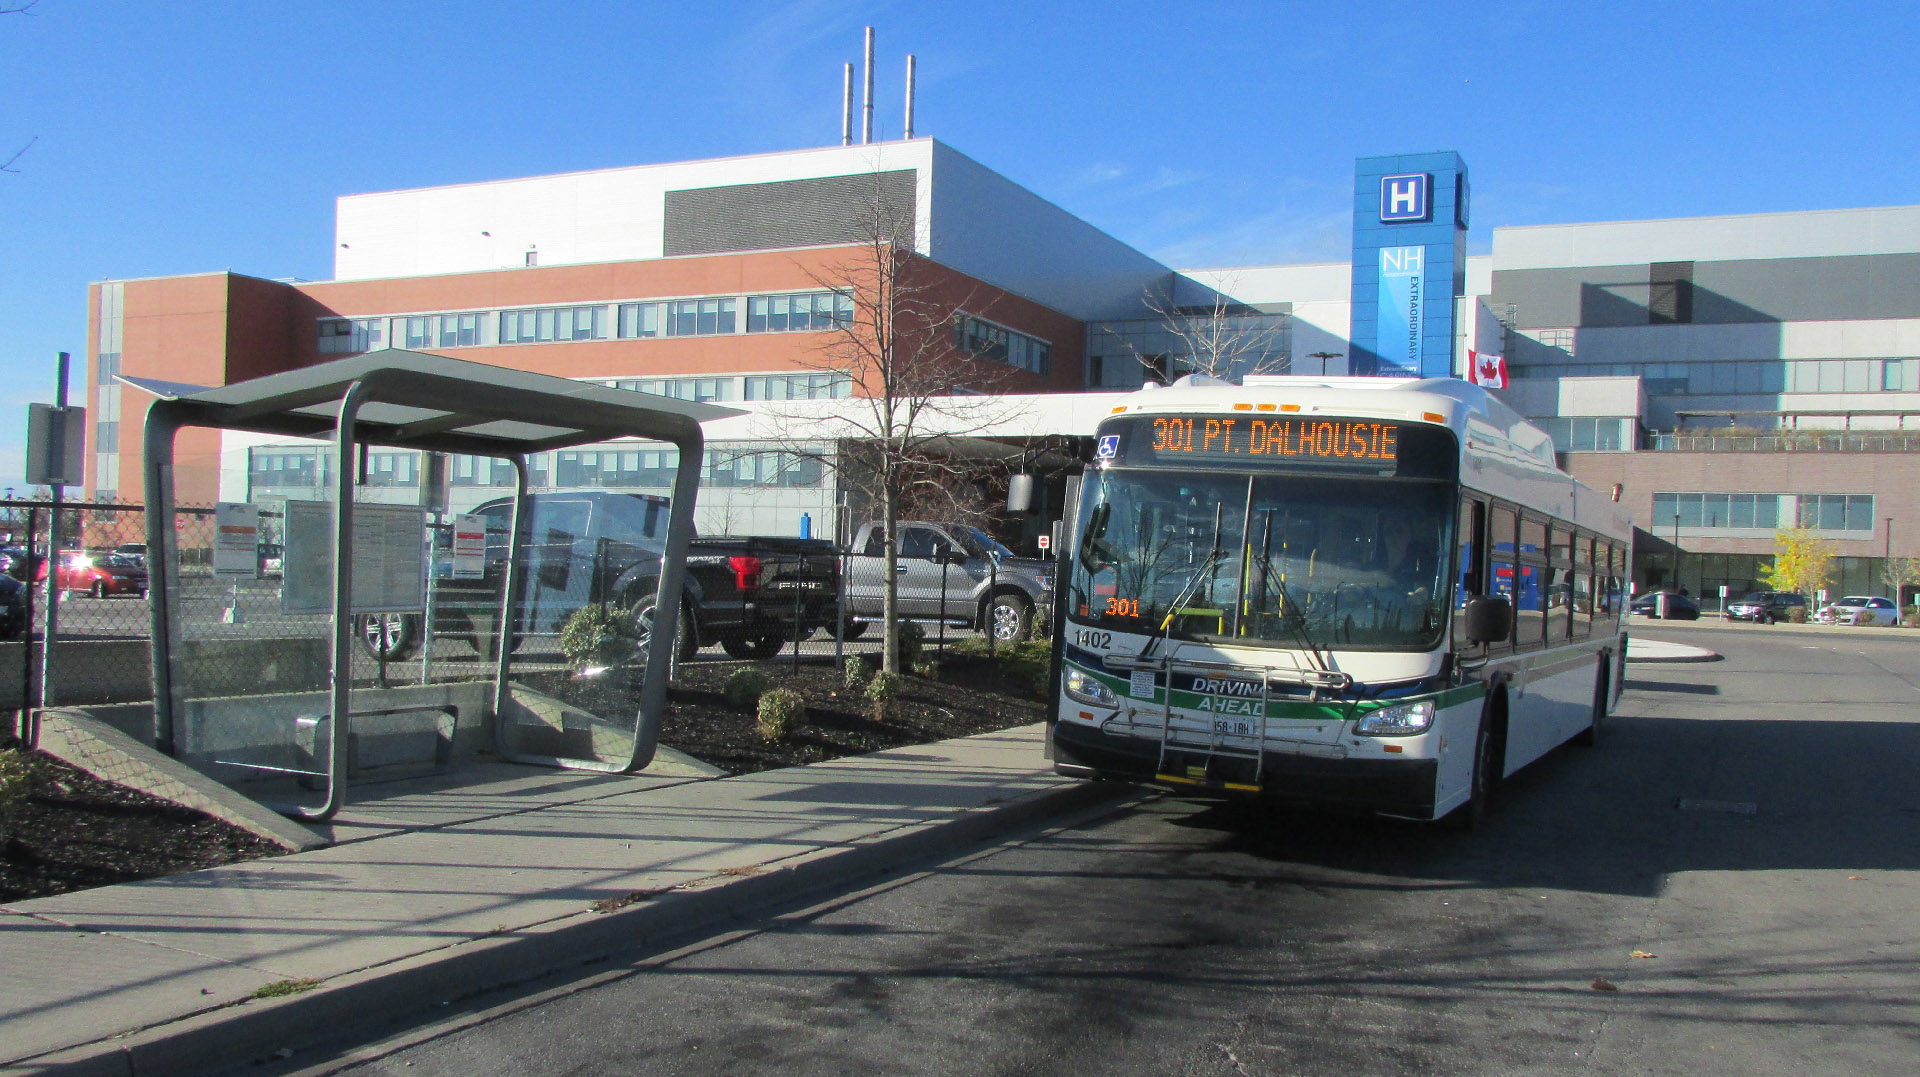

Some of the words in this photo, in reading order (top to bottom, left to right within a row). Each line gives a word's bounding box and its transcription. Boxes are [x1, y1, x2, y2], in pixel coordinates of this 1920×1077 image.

[1390, 181, 1416, 214] H
[1383, 248, 1422, 272] NH
[1409, 276, 1419, 360] EXTRAORDINARY
[1152, 418, 1193, 452] 301
[1203, 419, 1239, 453] PT.
[1249, 420, 1398, 459] DALHOUSIE
[1105, 597, 1139, 618] 301
[1075, 630, 1112, 650] 1402
[1197, 697, 1265, 716] AHEAD
